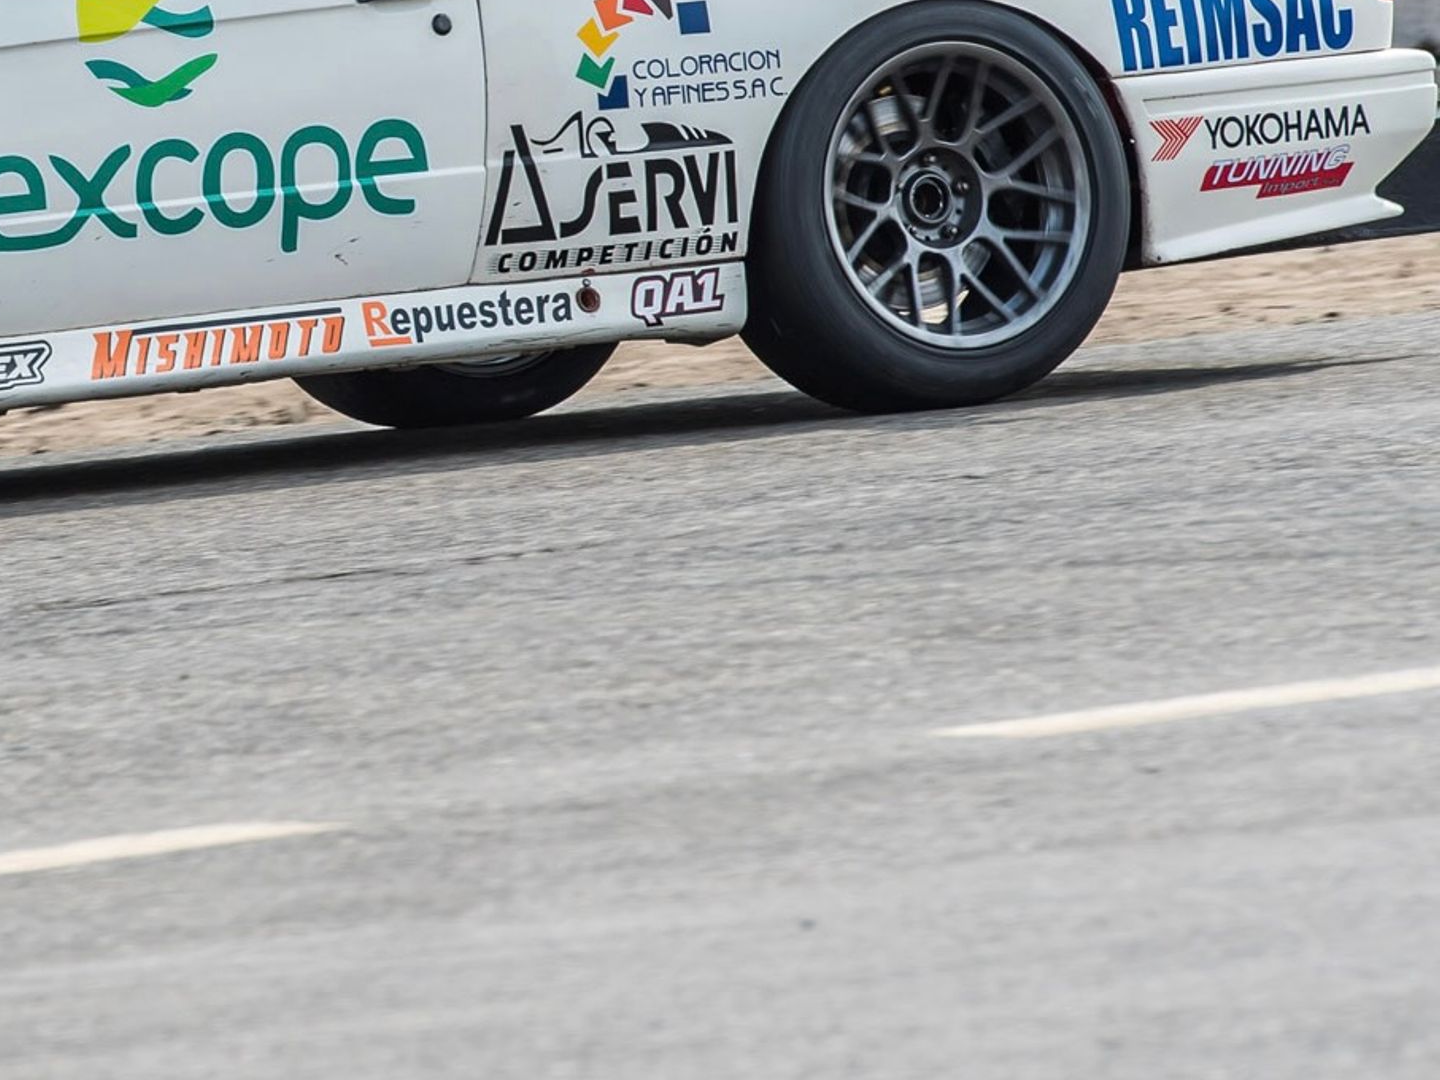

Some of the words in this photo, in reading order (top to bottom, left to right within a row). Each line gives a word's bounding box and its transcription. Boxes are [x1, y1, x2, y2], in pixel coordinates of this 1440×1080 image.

[632, 49, 781, 80] COLORACION
[634, 87, 647, 108] Y
[651, 81, 730, 107] AFINES
[1205, 104, 1371, 149] YOKOHAMA
[1212, 144, 1351, 186] TUNNING
[496, 227, 739, 273] COMPETICIÓN
[632, 268, 725, 327] QA1
[91, 317, 345, 381] MISHIMOTO
[361, 289, 572, 348] Repuestera
